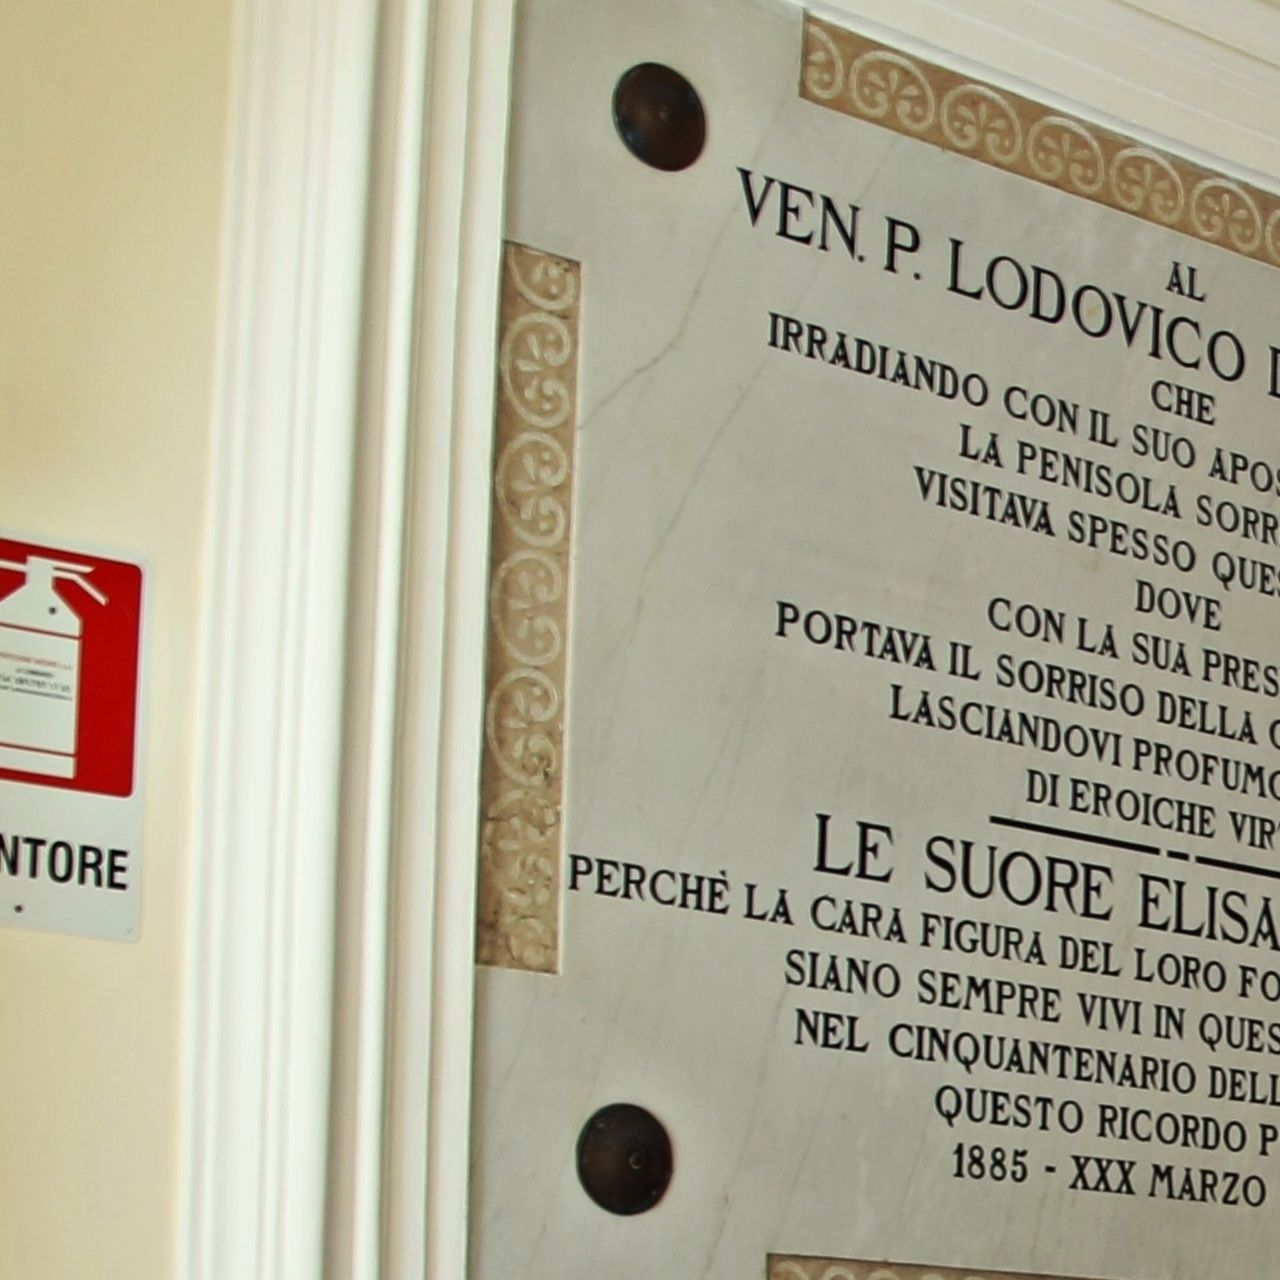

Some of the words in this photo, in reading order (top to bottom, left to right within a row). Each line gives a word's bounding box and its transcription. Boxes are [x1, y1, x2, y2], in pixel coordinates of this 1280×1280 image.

[735, 166, 866, 263] VEN.
[883, 215, 922, 281] P.
[946, 237, 1246, 383] LODOVICO
[1164, 260, 1207, 303] AL
[767, 311, 989, 408] IRRADIANDO
[1003, 385, 1080, 436] CON
[1087, 408, 1119, 449] IL
[1131, 423, 1197, 469] SUO
[1150, 379, 1216, 427] CHE
[958, 423, 1005, 469] LA
[1016, 440, 1183, 520] PENISOLA
[912, 465, 1057, 538] VISITAVA
[1067, 509, 1197, 573] SPESSO
[987, 597, 1067, 645] CON
[1076, 616, 1120, 660] LA
[1131, 631, 1193, 678] SUA
[1134, 578, 1222, 632] DOVE
[774, 600, 937, 672] PORTAVA
[947, 641, 982, 682] IL
[995, 653, 1145, 718] SORRISO
[1156, 689, 1259, 746] DELLA
[888, 683, 1123, 768] LASCIANDOVI
[1025, 768, 1061, 808] DI
[1068, 777, 1216, 839] EROICHE
[0, 832, 129, 891] NTORE
[812, 812, 894, 884] LE
[923, 835, 1114, 922] SUORE
[742, 882, 795, 927] LA
[809, 894, 908, 945] CARA
[919, 911, 1048, 967] FIGURA
[1058, 934, 1123, 978] DEL
[1133, 947, 1227, 994] LORO
[784, 948, 902, 999] SIANO
[917, 968, 1062, 1024] SEMPRE
[1076, 991, 1143, 1036] VIVI
[1153, 1003, 1186, 1041] IN
[793, 1007, 870, 1054] NEL
[887, 1022, 1197, 1095] CINQUANTENARIO
[934, 1084, 1084, 1134] QUESTO
[1096, 1103, 1248, 1153] RICORDO
[952, 1142, 1029, 1184] 1885
[1068, 1154, 1137, 1196] XXX
[1147, 1163, 1267, 1208] MARZO
